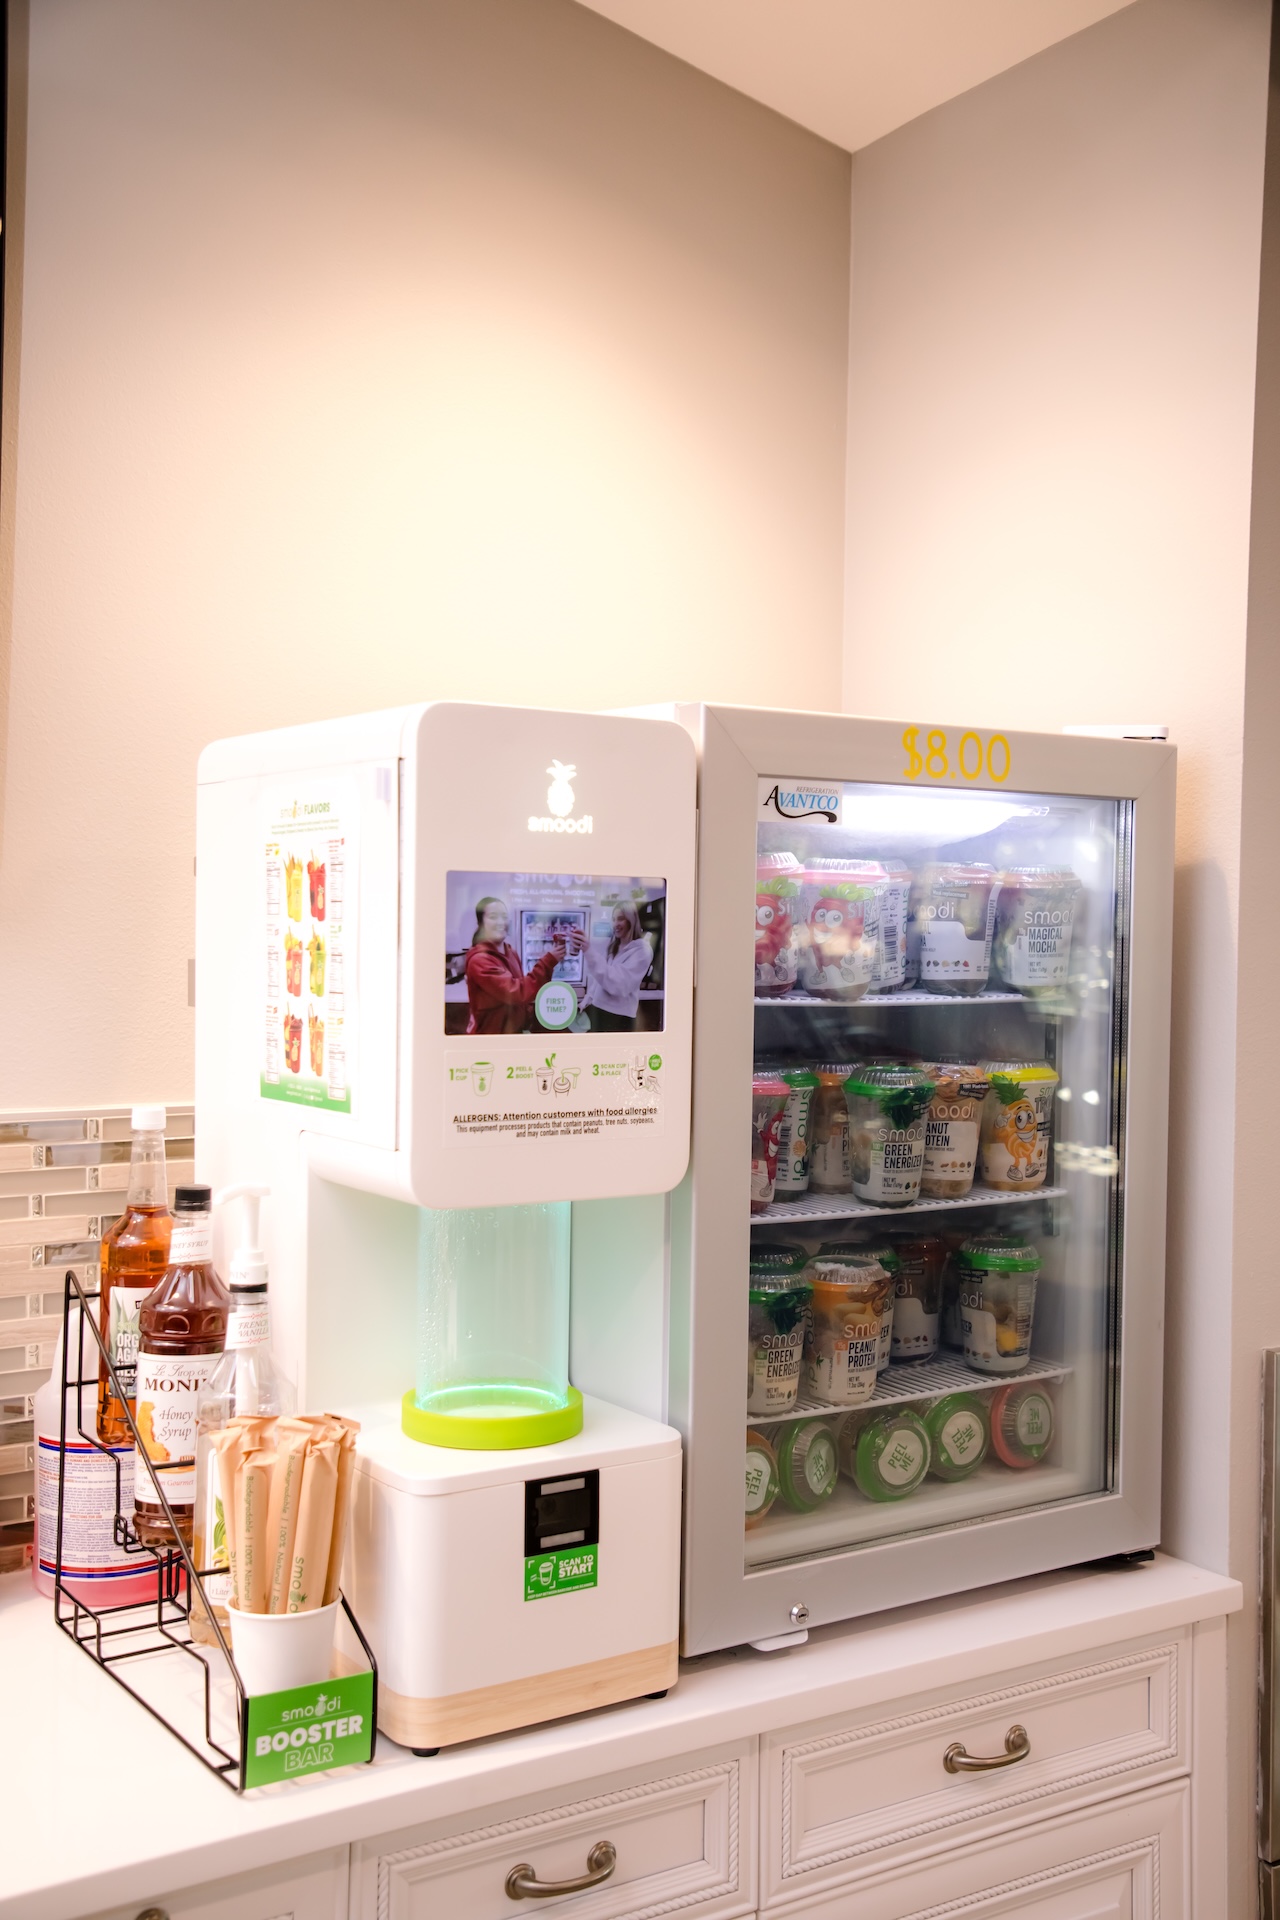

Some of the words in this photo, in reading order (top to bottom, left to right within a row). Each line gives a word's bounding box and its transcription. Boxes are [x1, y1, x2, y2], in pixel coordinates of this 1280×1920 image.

[902, 724, 1011, 783] $8.00
[796, 786, 839, 795] REFRIGERATION
[303, 802, 331, 815] FLAVORS
[763, 785, 839, 816] AVANTCO
[1028, 927, 1063, 940] MAGICAL
[1028, 940, 1057, 953] MOCHA
[546, 997, 566, 1005] FIRST
[546, 1005, 567, 1013] TIME?
[449, 1068, 455, 1081] 1
[506, 1066, 514, 1079] 2
[592, 1064, 600, 1076] 3
[453, 1113, 501, 1123] ALLERGENS:
[503, 1111, 541, 1121] Attention
[542, 1110, 586, 1119] customers
[587, 1108, 605, 1117] with
[606, 1107, 623, 1116] food
[624, 1106, 658, 1116] allergies
[456, 1124, 468, 1133] This
[469, 1124, 498, 1134] equipment
[499, 1123, 526, 1132] processes
[527, 1121, 551, 1131] products
[551, 1120, 562, 1128] that
[563, 1119, 582, 1128] contain
[605, 1118, 616, 1126] tree
[516, 1130, 526, 1138] and
[527, 1130, 539, 1138] may
[540, 1129, 559, 1137] contain
[560, 1128, 571, 1136] milk
[572, 1127, 583, 1135] and
[884, 1143, 913, 1156] GREEN
[849, 1339, 877, 1355] PEANUT
[768, 1349, 795, 1364] GREEN
[848, 1355, 876, 1368] PROTEIN
[151, 1364, 166, 1377] Le
[167, 1364, 195, 1381] Sirop
[197, 1367, 208, 1376] de
[159, 1406, 194, 1424] Honey
[1029, 1407, 1040, 1419] ME
[157, 1422, 192, 1442] Syrup
[962, 1424, 976, 1443] ME
[1026, 1422, 1043, 1435] PEEL
[951, 1428, 969, 1455] PEEL
[887, 1443, 907, 1469] PEEL
[898, 1454, 915, 1472] ME
[166, 1478, 194, 1487] Gourmet
[282, 1454, 295, 1514] Biodegradable
[747, 1468, 763, 1496] PEEL
[244, 1475, 254, 1533] Biodegradable
[279, 1525, 288, 1548] 100%
[244, 1544, 253, 1570] 100%
[558, 1557, 581, 1568] SCAN
[582, 1554, 594, 1563] TO
[274, 1551, 284, 1586] Natural
[558, 1561, 594, 1578] START
[215, 1588, 229, 1596] Liter
[244, 1569, 253, 1602] Natural
[255, 1714, 364, 1757] BOOSTER
[284, 1742, 335, 1773] BAR
